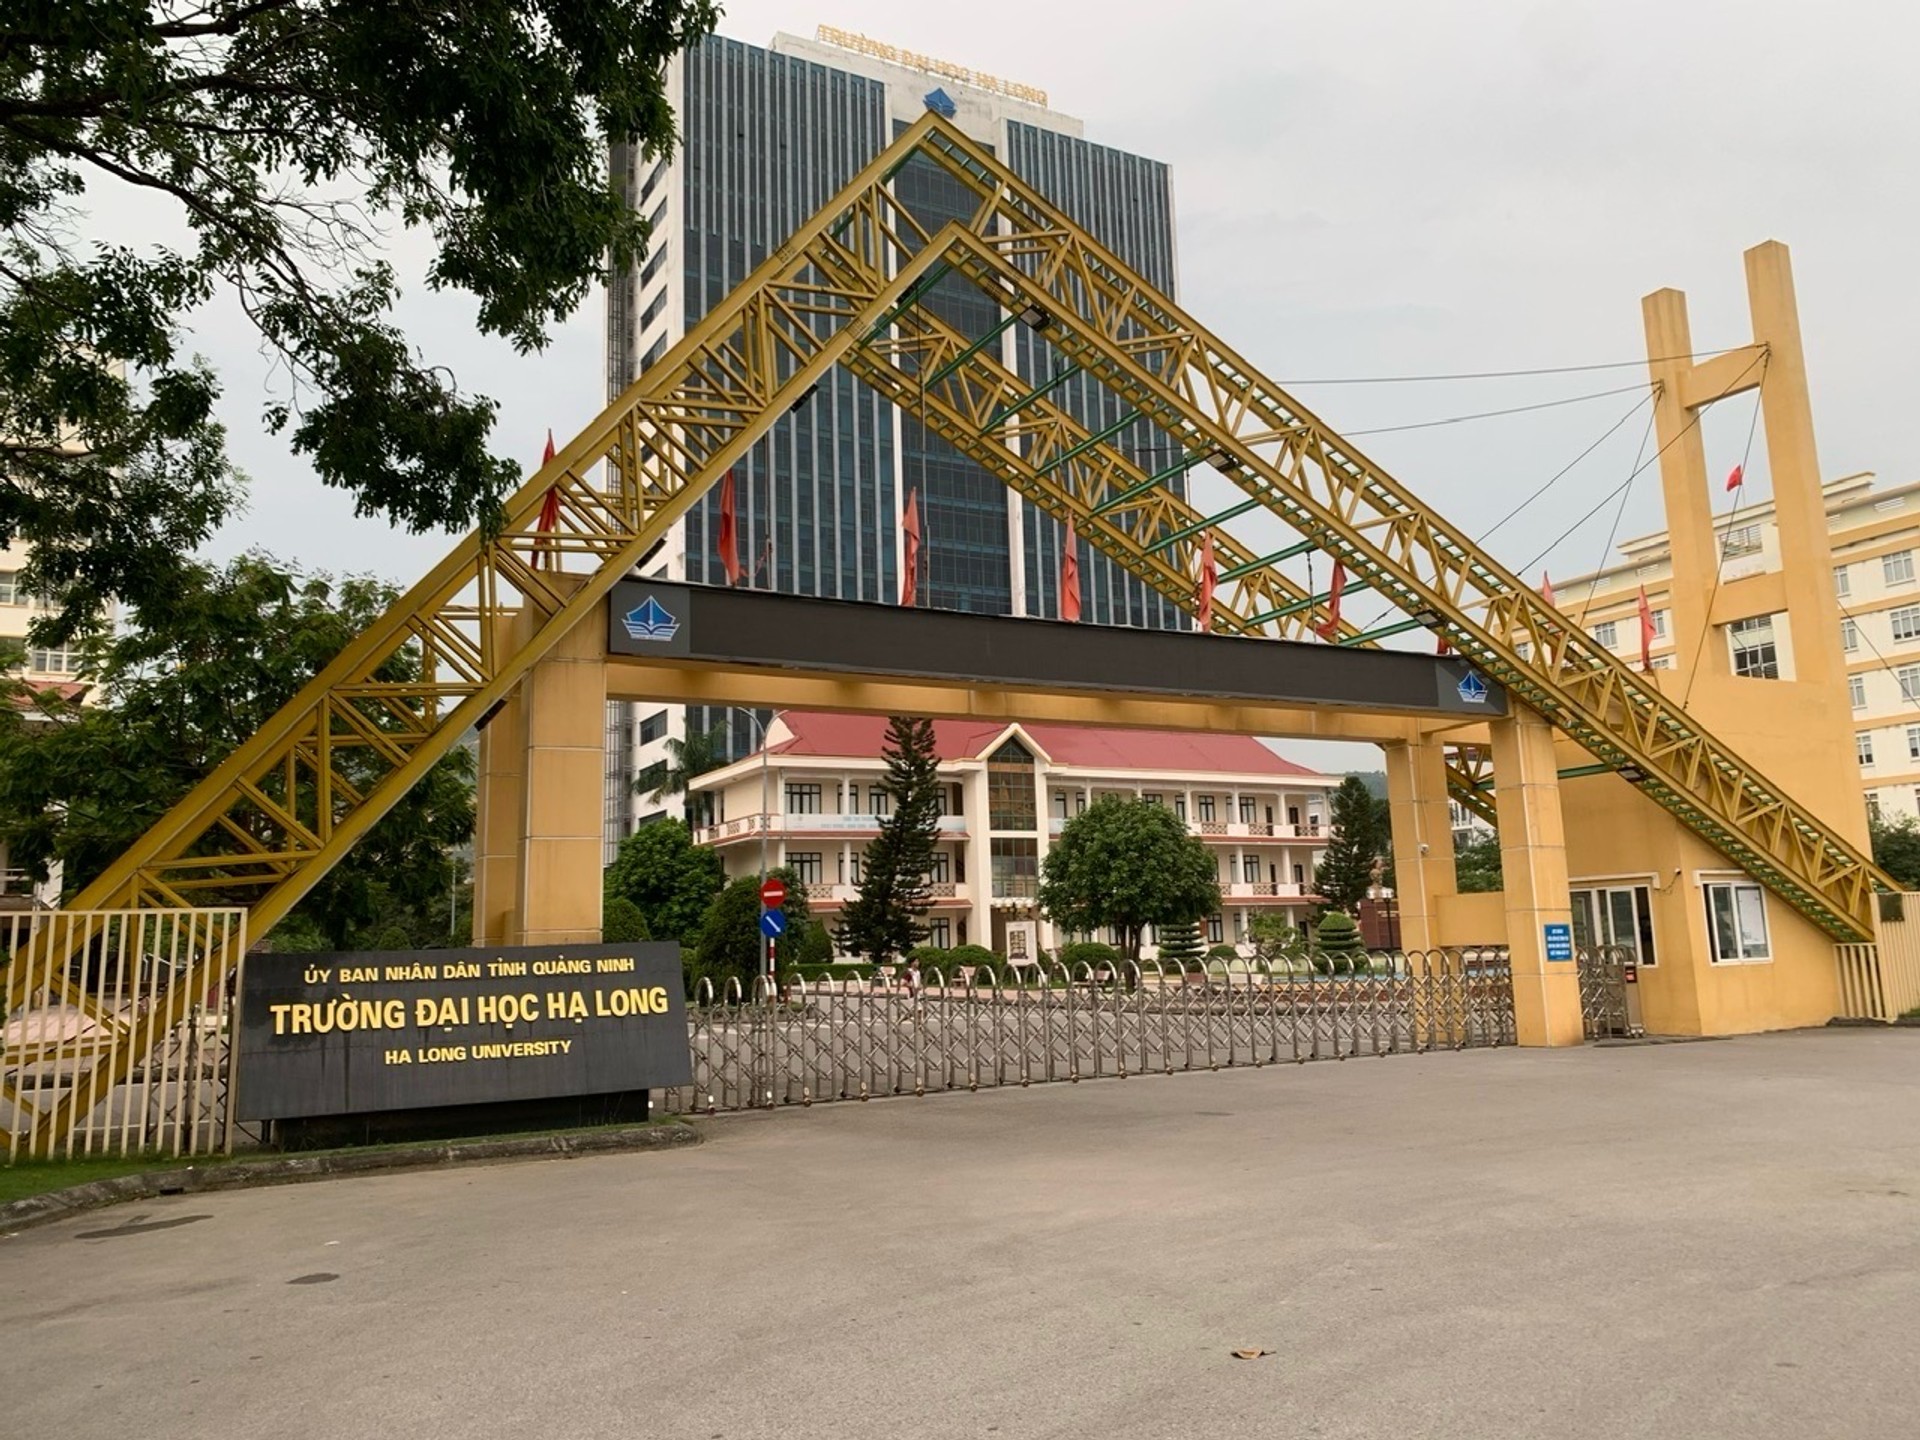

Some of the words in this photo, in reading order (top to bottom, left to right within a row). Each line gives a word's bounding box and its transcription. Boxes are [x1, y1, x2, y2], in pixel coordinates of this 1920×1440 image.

[304, 963, 332, 984] ỦY
[339, 967, 379, 983] BAN
[385, 962, 437, 981] NHÂN
[444, 961, 481, 979] DÂN
[486, 957, 527, 977] TỈNH
[532, 954, 592, 976] QUẢNG
[596, 957, 635, 973] NINH
[269, 993, 406, 1035] TRƯỜNG
[415, 997, 471, 1032] ĐẠI
[477, 993, 540, 1029] HỌC
[546, 991, 588, 1023] HẠ
[595, 986, 669, 1017] LONG
[384, 1049, 412, 1065] HA
[418, 1046, 467, 1063] LONG
[471, 1039, 572, 1059] UNIVERSITY
